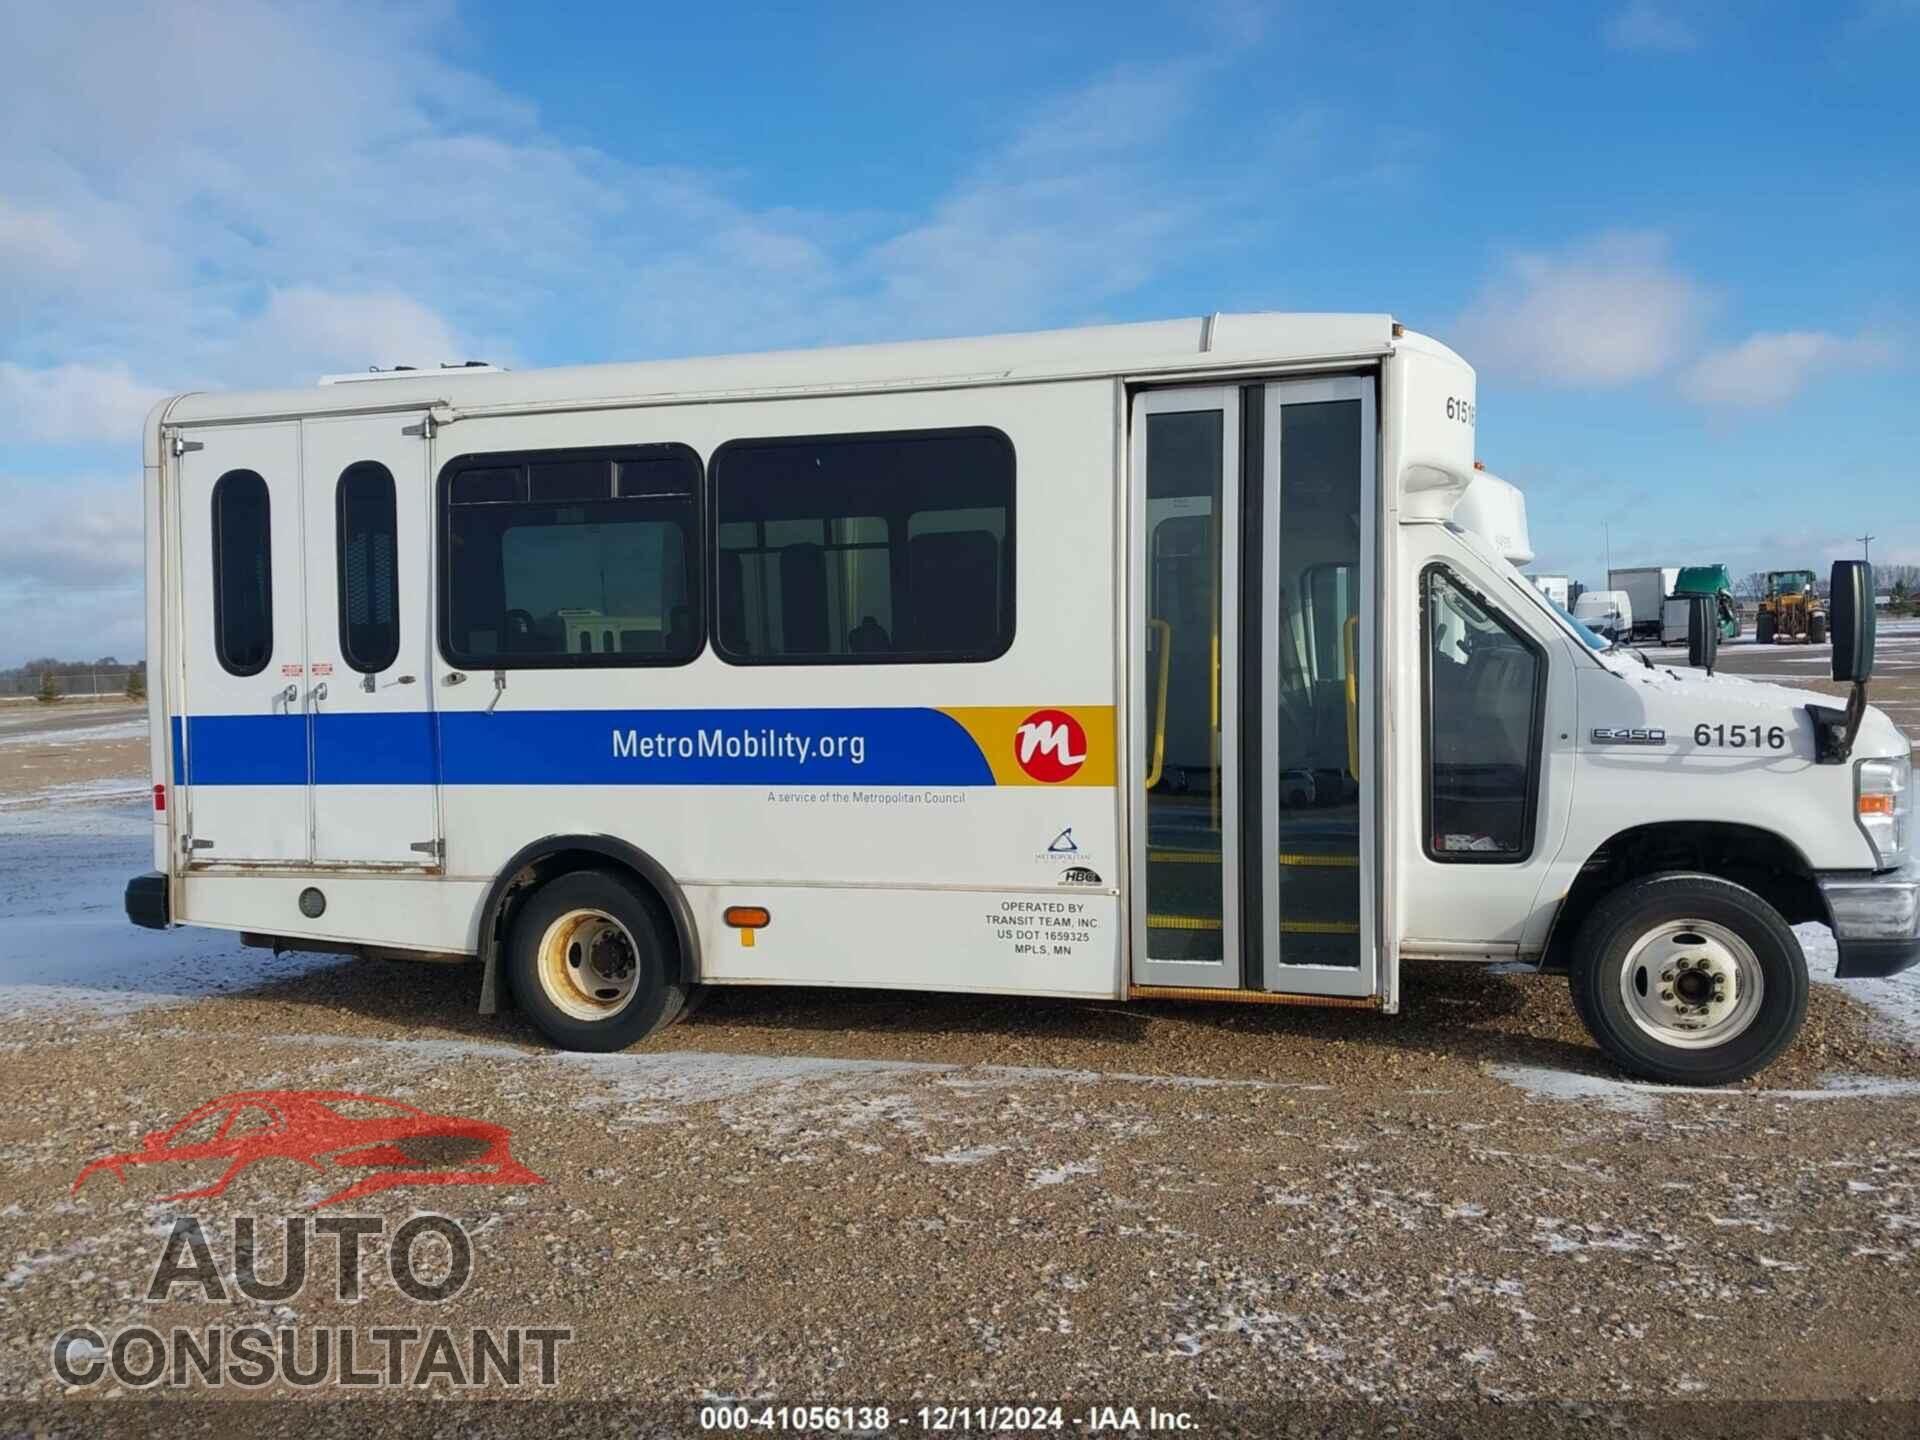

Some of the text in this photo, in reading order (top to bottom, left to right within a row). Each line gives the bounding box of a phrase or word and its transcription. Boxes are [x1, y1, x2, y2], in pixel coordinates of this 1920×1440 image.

[1694, 723, 1785, 749] 61516
[612, 729, 865, 764] MetroMobility.org
[767, 791, 966, 806] A service of the Metropolitan Council
[1001, 902, 1084, 913] OPERATED BY
[986, 915, 1034, 926] TRANSIT
[1039, 916, 1074, 928] TEAM,
[997, 929, 1090, 942] US DOT 1659325
[1015, 944, 1072, 956] MPLS, MN
